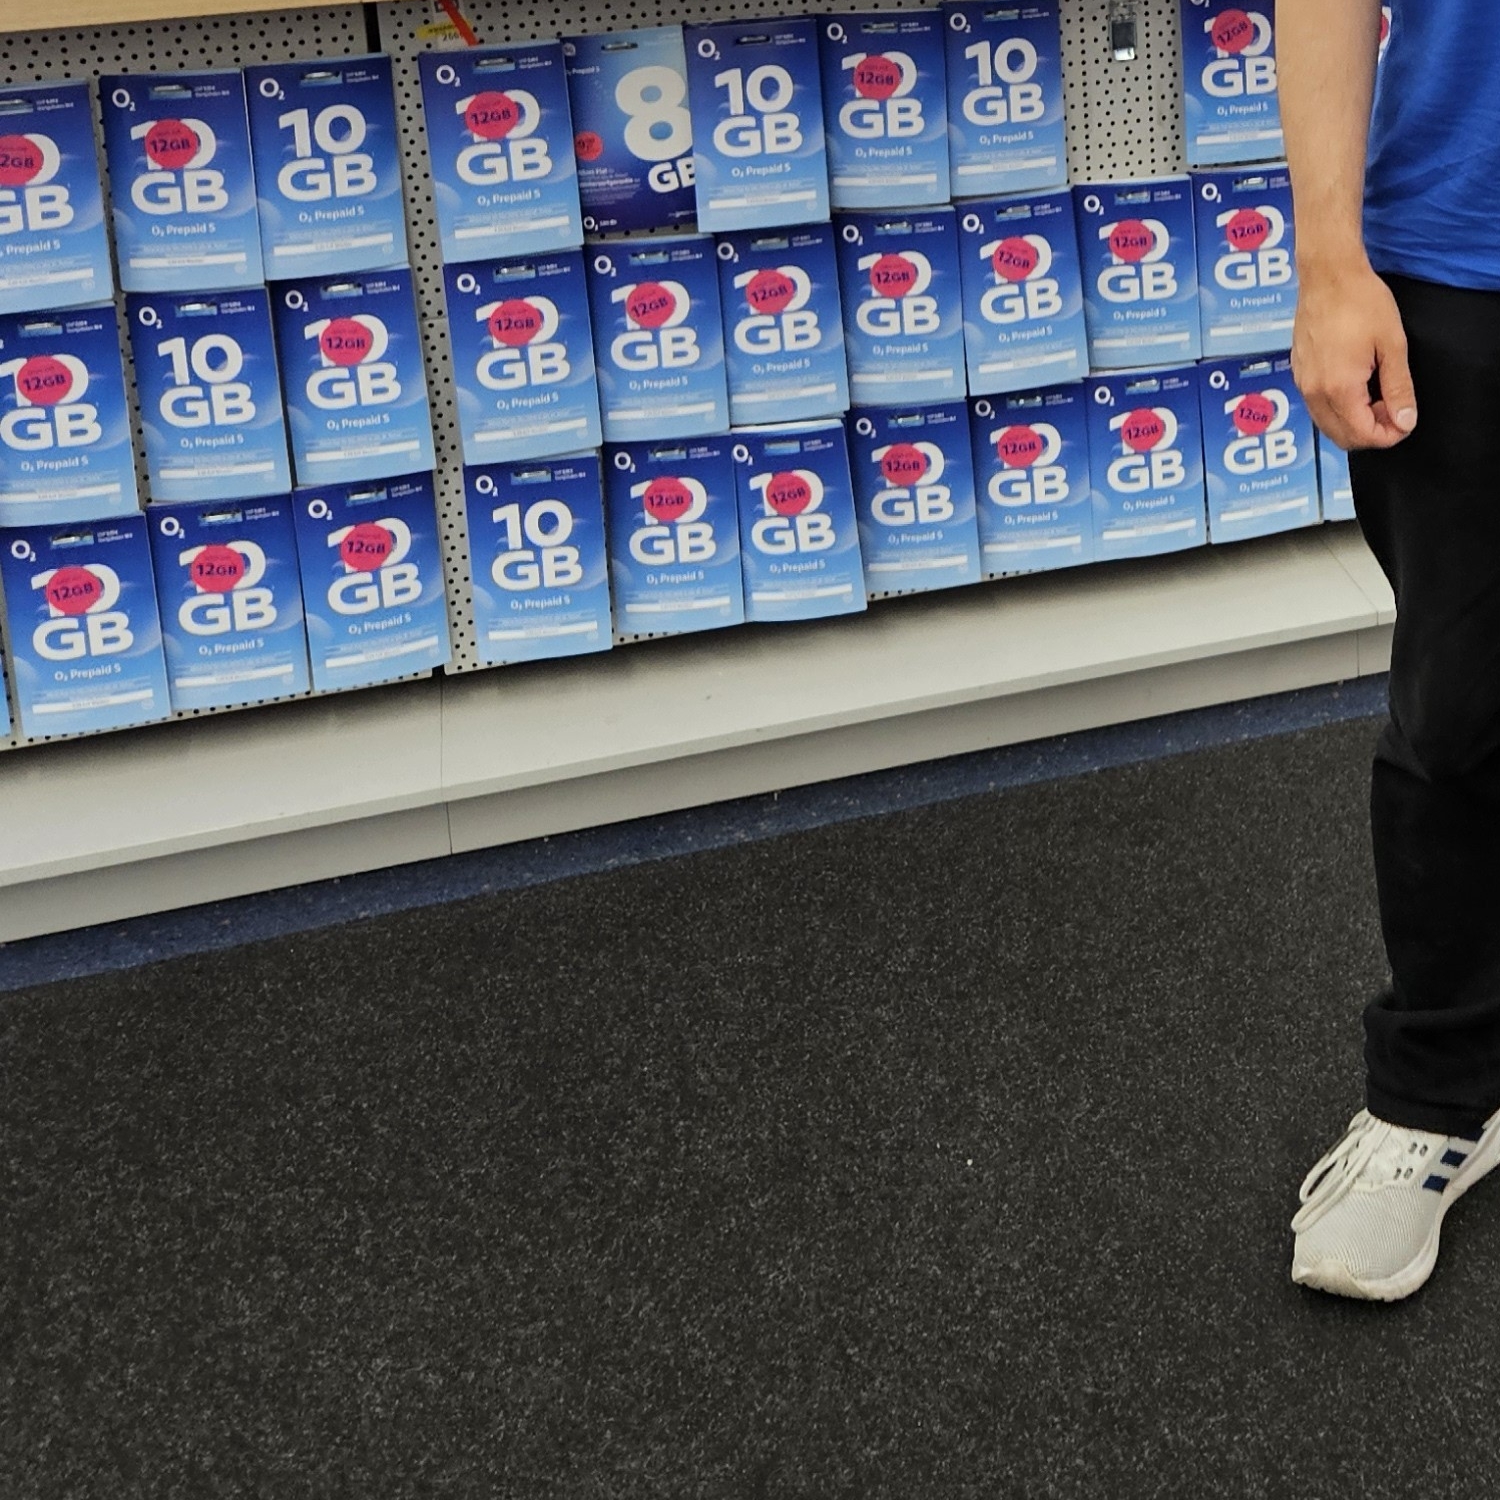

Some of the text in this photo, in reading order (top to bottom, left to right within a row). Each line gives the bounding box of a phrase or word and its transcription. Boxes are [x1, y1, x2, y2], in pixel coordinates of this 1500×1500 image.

[859, 71, 894, 85] 12GB
[966, 38, 1037, 86] 10
[1202, 56, 1277, 98] GB
[715, 65, 793, 115] 10
[963, 83, 1045, 126] GB
[279, 104, 366, 158] 10
[470, 108, 512, 125] 12GB
[615, 65, 693, 162] 8
[839, 99, 924, 138] GB
[150, 138, 191, 153] 12GB
[714, 113, 802, 157] GB
[994, 132, 1026, 144] Prepaid
[0, 154, 34, 168] 2GB
[278, 154, 377, 201] GB
[456, 138, 552, 185] GB
[747, 164, 782, 177] Prepaid
[131, 170, 227, 215] GB
[494, 191, 532, 205] Prepaid
[168, 224, 206, 236] Prepaid
[316, 208, 355, 221] Prepaid
[998, 250, 1031, 269] 12GB
[1114, 236, 1148, 248] 12GB
[875, 271, 910, 284] 12GB
[1098, 263, 1177, 303] GB
[1214, 247, 1293, 290] GB
[631, 297, 669, 318] 12GB
[751, 285, 788, 302] 12GB
[981, 279, 1062, 324] GB
[494, 317, 536, 332] 12GB
[734, 311, 820, 355] GB
[856, 297, 939, 336] GB
[158, 335, 242, 385] 10
[326, 336, 366, 350] 12GB
[611, 327, 699, 371] GB
[23, 374, 66, 391] 12GB
[306, 363, 400, 410] GB
[476, 343, 570, 390] GB
[159, 383, 254, 428] GB
[343, 415, 381, 429] Prepaid
[0, 404, 101, 450] GB
[197, 436, 235, 448] Prepaid
[38, 458, 79, 471] Prepaid
[885, 460, 921, 472] 12GB
[1002, 441, 1037, 456] 12GB
[1223, 429, 1298, 475] GB
[988, 466, 1069, 507] GB
[1107, 450, 1185, 493] GB
[648, 494, 685, 507] 12GB
[771, 487, 806, 504] 12GB
[871, 486, 953, 526] GB
[493, 500, 572, 550] 10
[629, 523, 715, 565] GB
[751, 514, 834, 555] GB
[347, 540, 386, 554] 12GB
[196, 562, 238, 577] 12GB
[491, 547, 582, 591] GB
[52, 582, 94, 601] 12GB
[328, 564, 422, 615] GB
[178, 588, 276, 636] GB
[32, 612, 132, 661] GB
[72, 666, 111, 680] Prepaid
